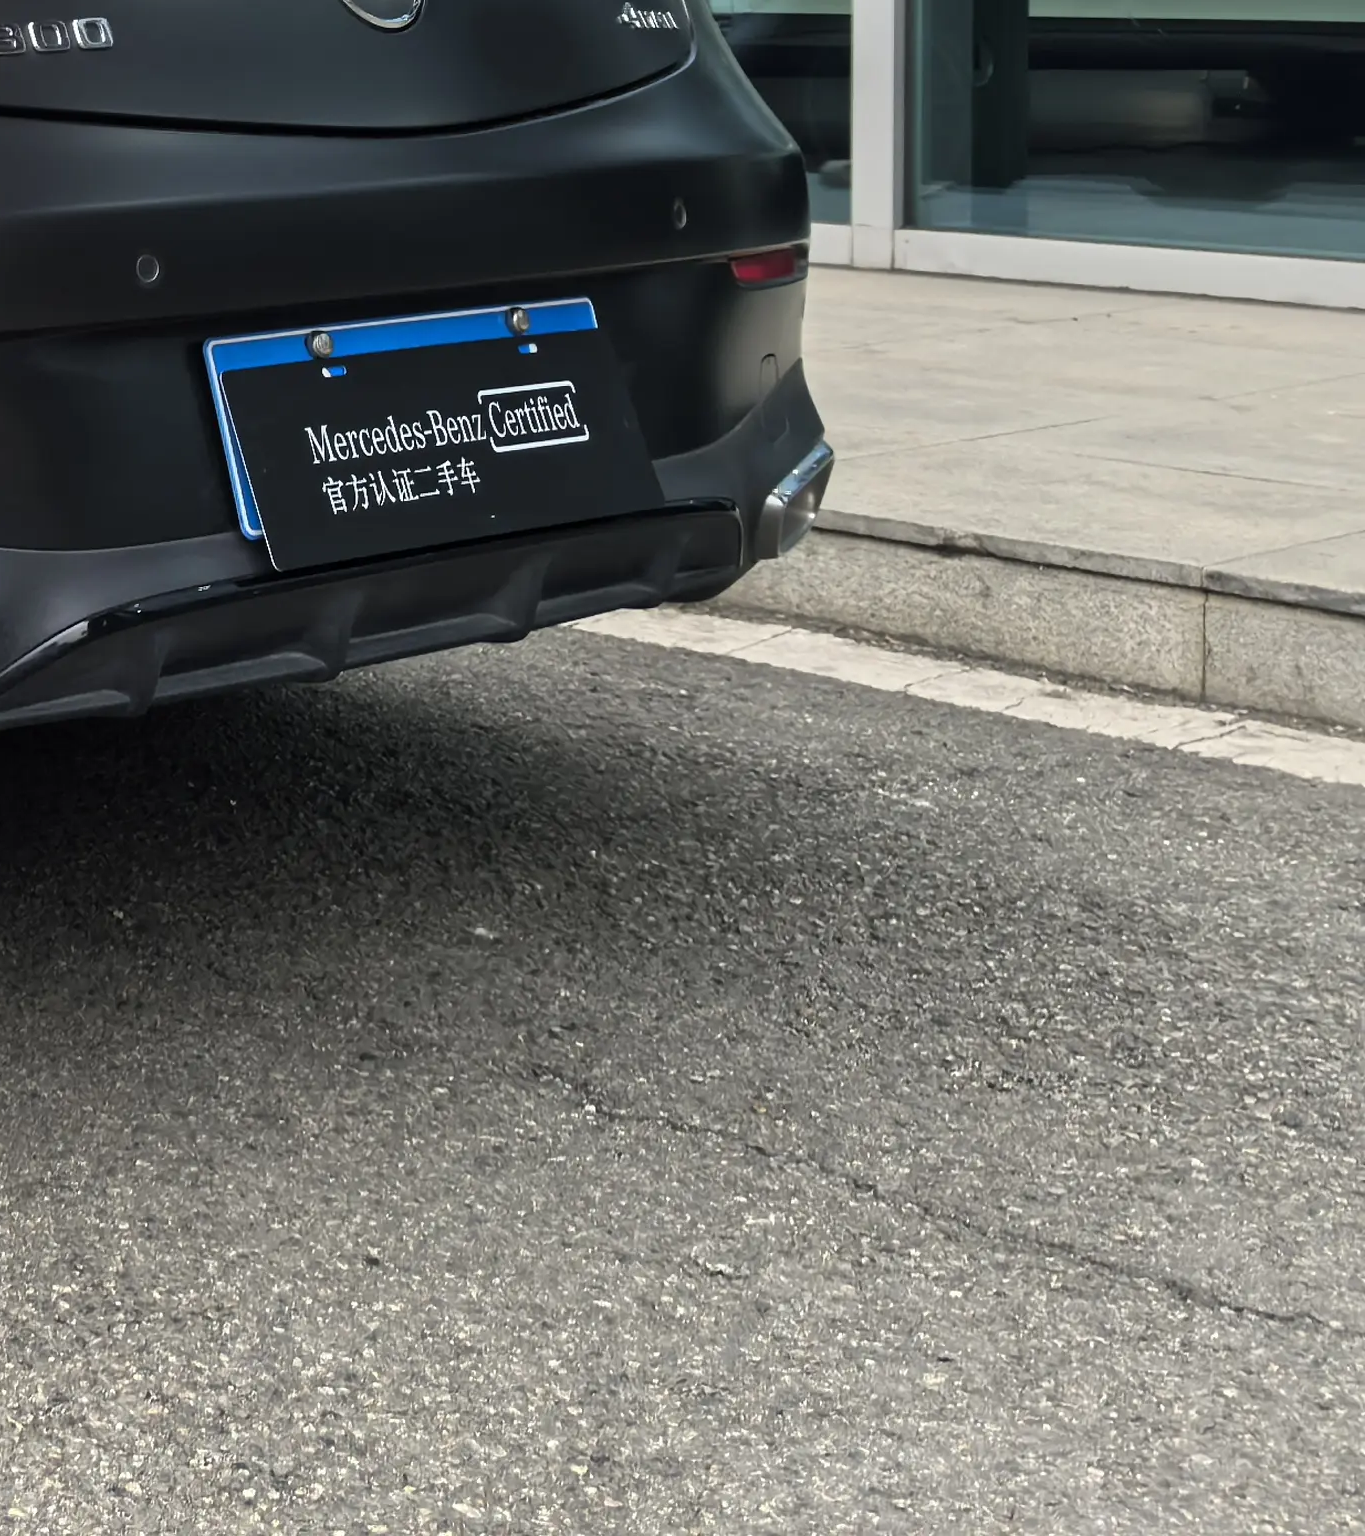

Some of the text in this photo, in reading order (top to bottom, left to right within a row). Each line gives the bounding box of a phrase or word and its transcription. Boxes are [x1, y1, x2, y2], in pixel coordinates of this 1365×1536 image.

[305, 393, 581, 464] Mercedes-Benz Certified
[322, 457, 481, 515] 官方认证二手车
